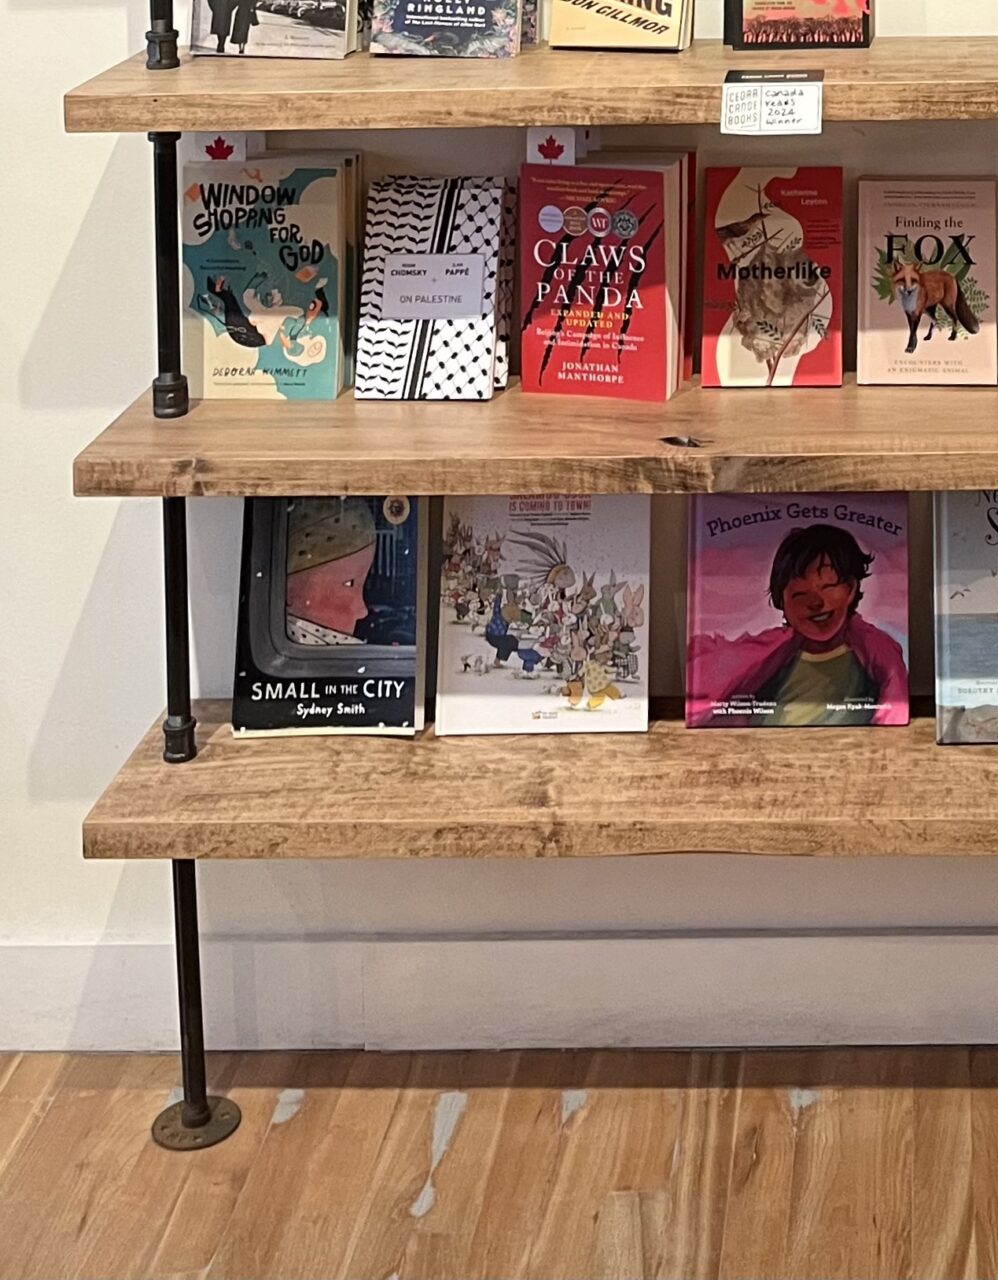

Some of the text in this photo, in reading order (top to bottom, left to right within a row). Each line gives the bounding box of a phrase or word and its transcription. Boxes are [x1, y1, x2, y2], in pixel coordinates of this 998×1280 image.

[407, 3, 486, 15] RINGLAND
[596, 5, 670, 35] GILLMOR
[728, 113, 758, 126] BOOKS
[768, 108, 795, 116] 2024
[200, 183, 296, 210] WINDOW
[193, 205, 286, 237] SHOPPING
[896, 216, 963, 231] Finding the
[270, 224, 303, 245] FOR
[279, 240, 324, 271] GOD
[533, 239, 646, 273] CLAWS
[883, 234, 977, 266] FOX
[445, 267, 469, 276] PAPPÉ
[553, 268, 624, 285] OF THE
[717, 262, 832, 281] Motherlike
[399, 295, 463, 303] ON PALESTINE
[536, 281, 644, 309] PANDA
[551, 309, 629, 320] EXPANDED AND
[566, 318, 613, 328] UPDATED
[562, 361, 619, 372] JONATHAN
[557, 372, 624, 384] MANTHORPE
[509, 501, 517, 511] IS
[706, 503, 903, 537] Phoenix Gets Greater
[251, 680, 405, 700] SMALL IN THE CITY
[296, 703, 366, 719] Sydney Smith
